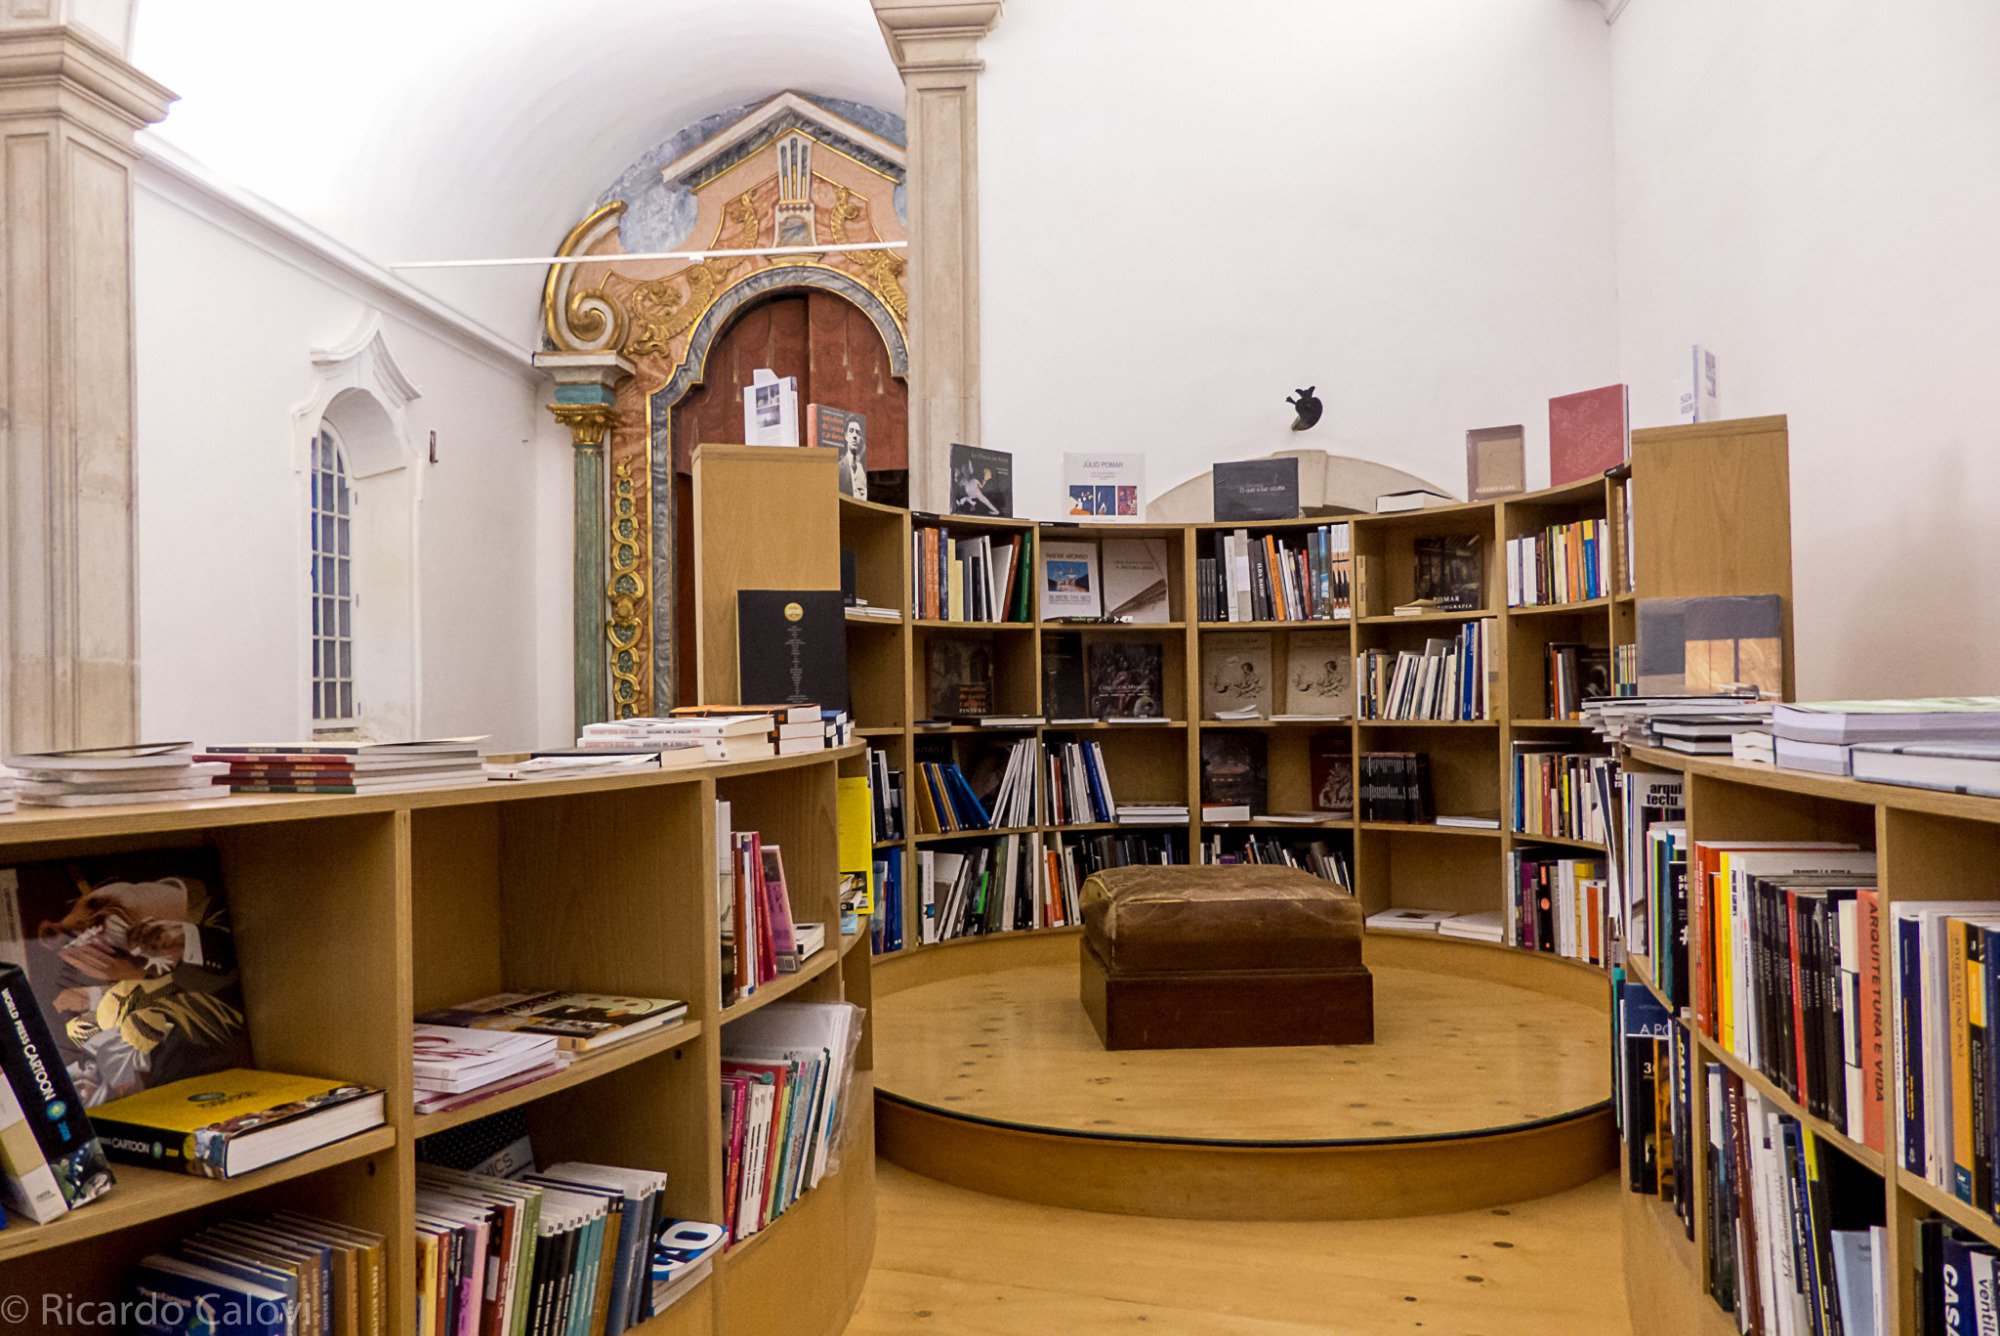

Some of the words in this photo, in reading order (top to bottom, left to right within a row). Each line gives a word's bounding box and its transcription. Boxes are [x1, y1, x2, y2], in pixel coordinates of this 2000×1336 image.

[1649, 783, 1683, 795] arqui
[1646, 794, 1678, 806] tectu
[1868, 902, 1883, 1041] ARQUITETURA
[1640, 1023, 1651, 1036] A
[0, 988, 21, 1020] WORLD
[14, 1016, 31, 1045] PRESS
[23, 1043, 54, 1104] CARTOON
[1873, 1043, 1883, 1055] E
[1874, 1061, 1884, 1102] VIDA
[111, 1137, 151, 1154] CARTOON
